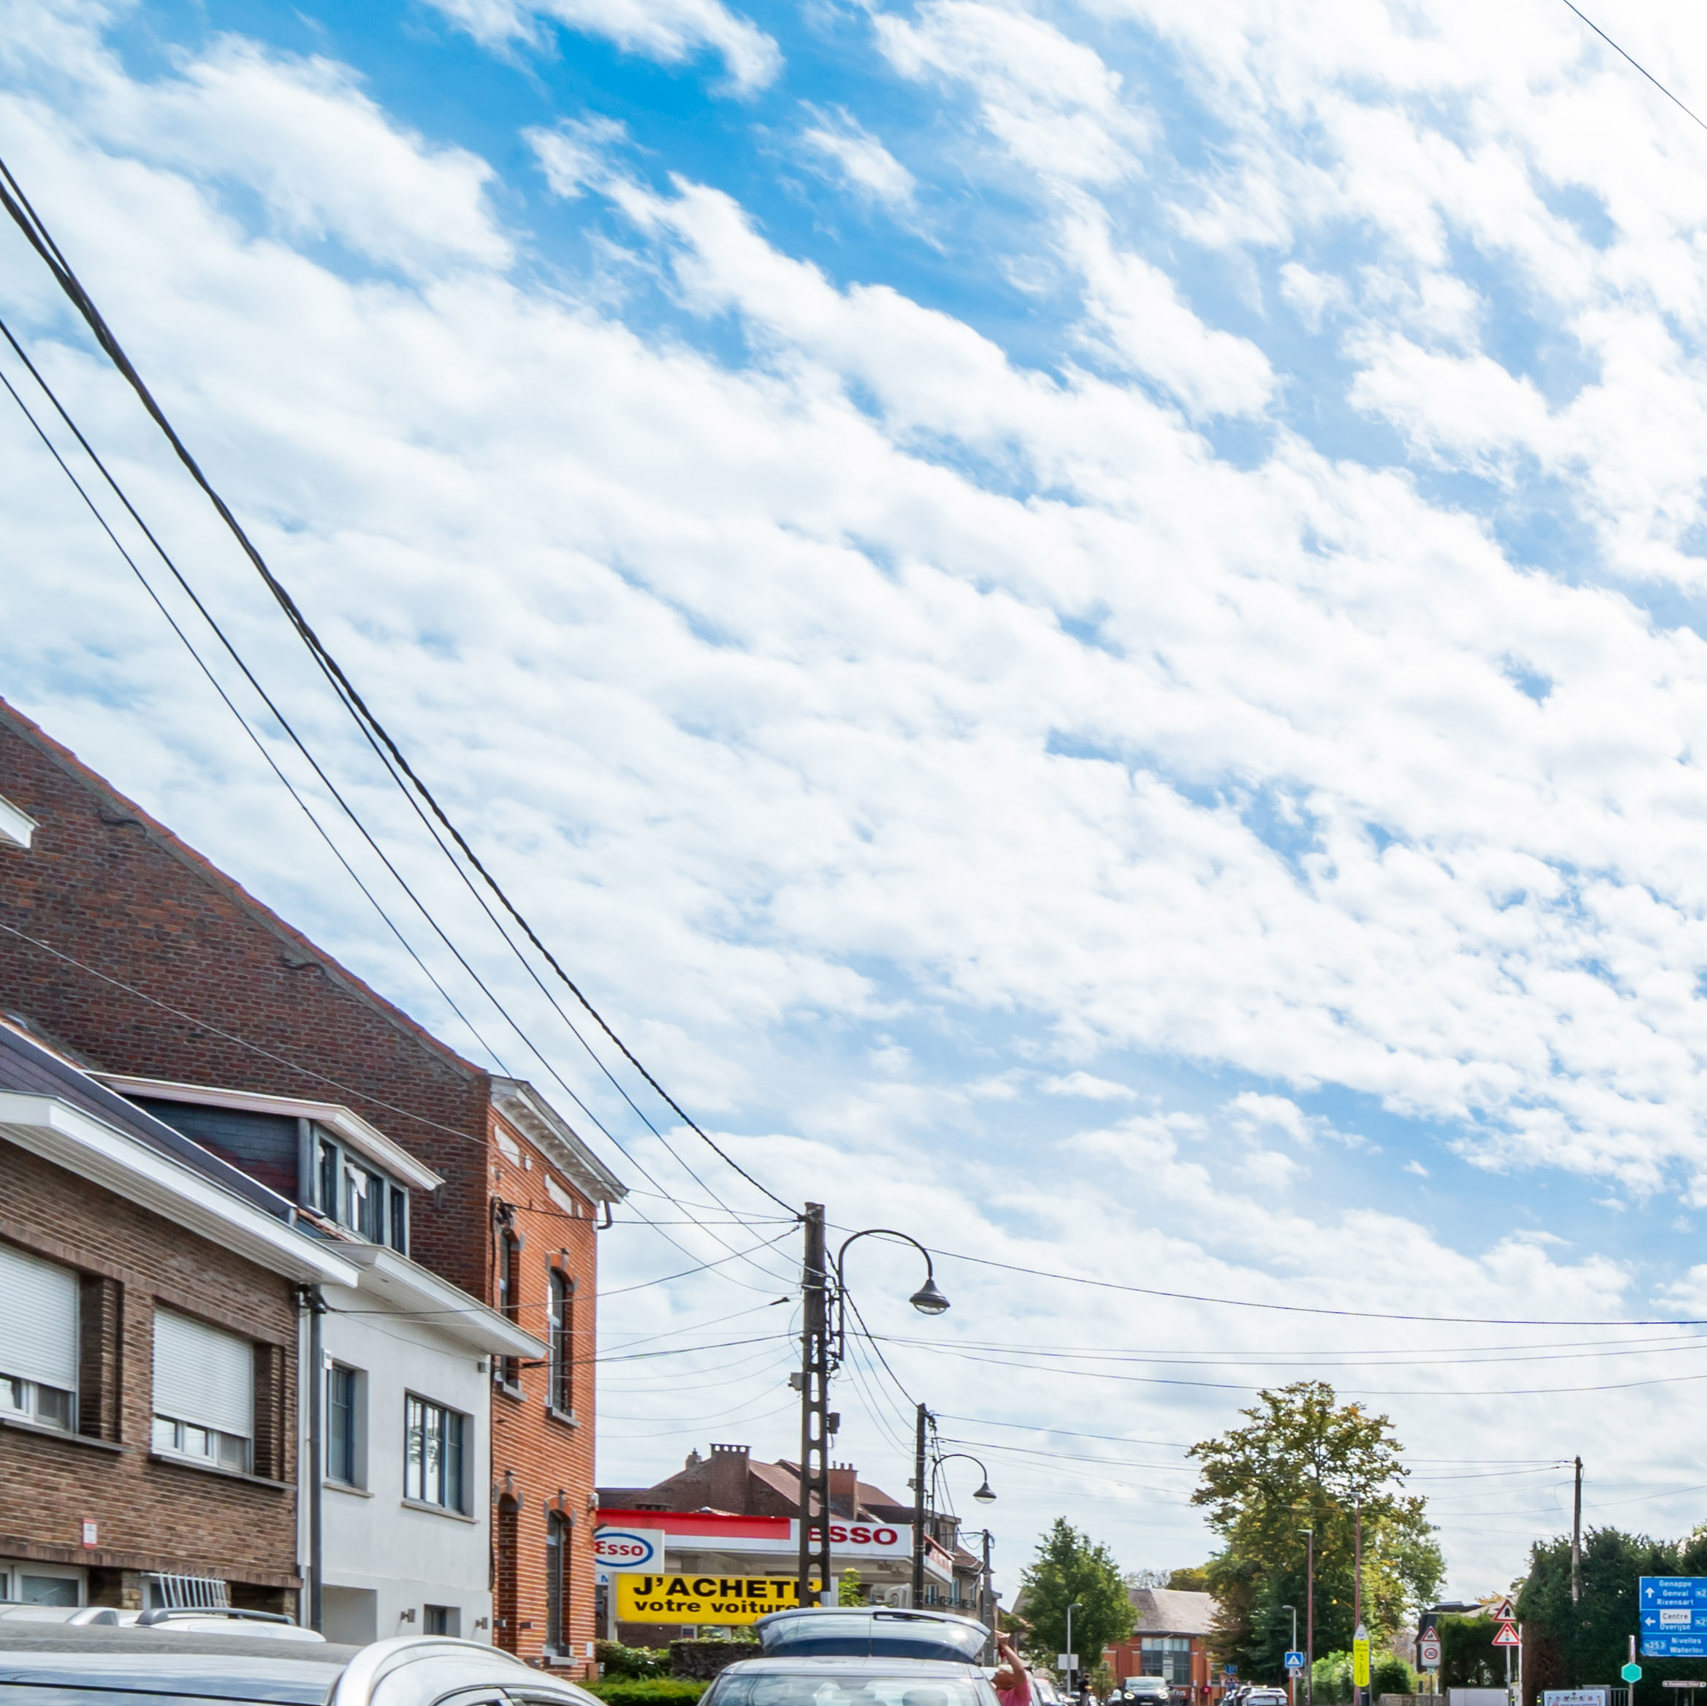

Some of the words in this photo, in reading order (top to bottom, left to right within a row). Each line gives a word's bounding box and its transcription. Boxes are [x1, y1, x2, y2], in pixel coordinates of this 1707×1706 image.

[595, 1541, 643, 1556] Esso
[1659, 1580, 1692, 1588] Genappe
[634, 1600, 700, 1613] votre
[1662, 1612, 1688, 1620] Centre
[1660, 1624, 1691, 1632] Overijse
[1670, 1645, 1703, 1653] Waterloo
